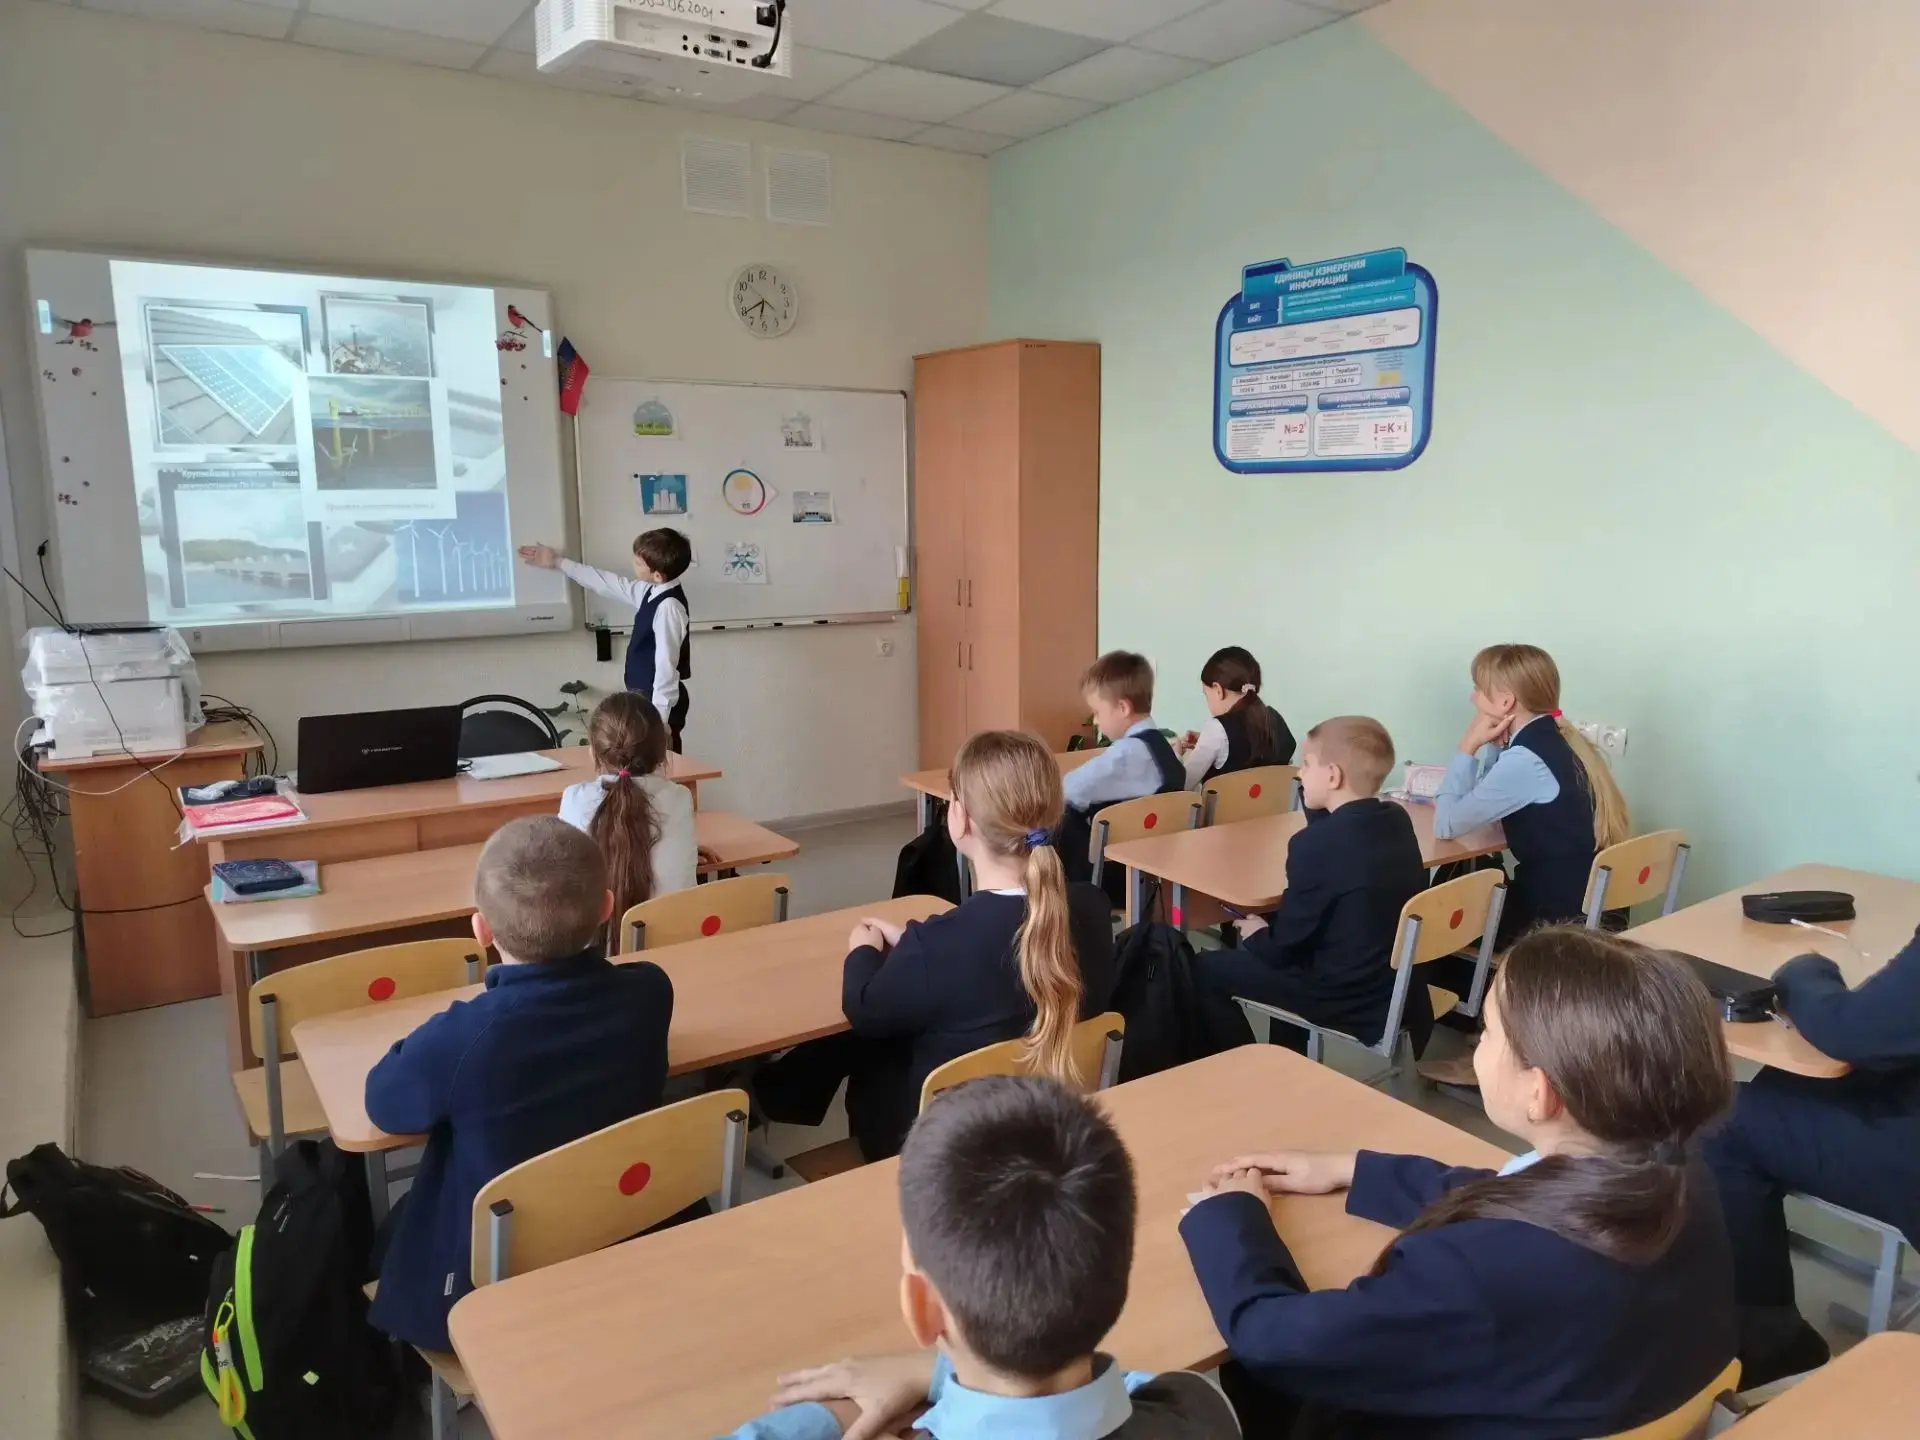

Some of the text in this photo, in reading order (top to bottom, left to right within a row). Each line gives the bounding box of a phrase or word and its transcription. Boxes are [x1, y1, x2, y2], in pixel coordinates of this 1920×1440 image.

[758, 270, 767, 281] 12
[1274, 259, 1367, 284] ЕДИНИЦЫ ИЗМЕРЕНИЯ
[747, 271, 754, 283] 11
[1289, 273, 1348, 291] ИНФОРМАЦИИ
[739, 281, 748, 291] 10
[737, 293, 744, 303] 9
[1249, 302, 1261, 310] БИТ
[749, 316, 755, 326] 7
[1247, 314, 1262, 324] БАЙТ
